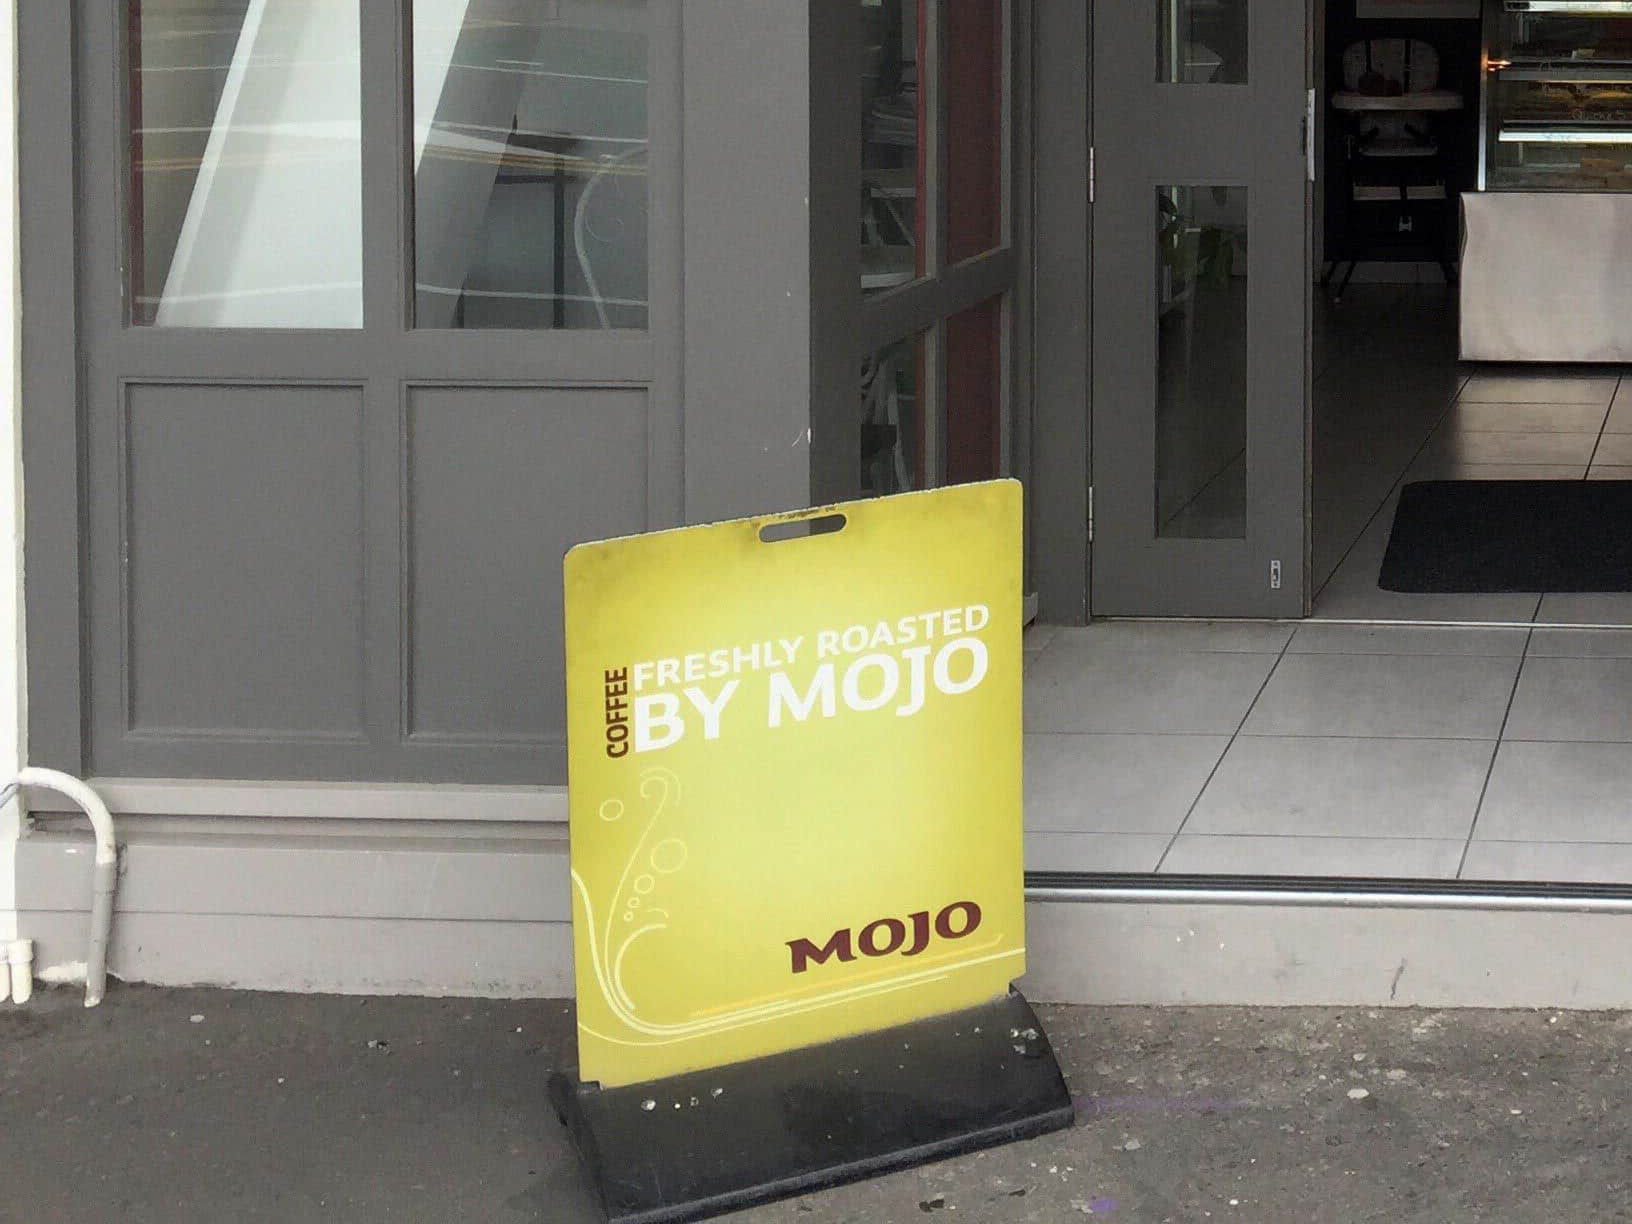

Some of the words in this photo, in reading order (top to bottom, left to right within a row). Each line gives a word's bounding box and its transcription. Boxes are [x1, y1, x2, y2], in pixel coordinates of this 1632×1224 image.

[633, 635, 803, 691] FRESHLY
[817, 603, 991, 658] ROASTED
[604, 665, 629, 759] COFFEE
[634, 679, 740, 753] BY
[766, 637, 990, 728] MOJO
[784, 900, 983, 975] MOJO
